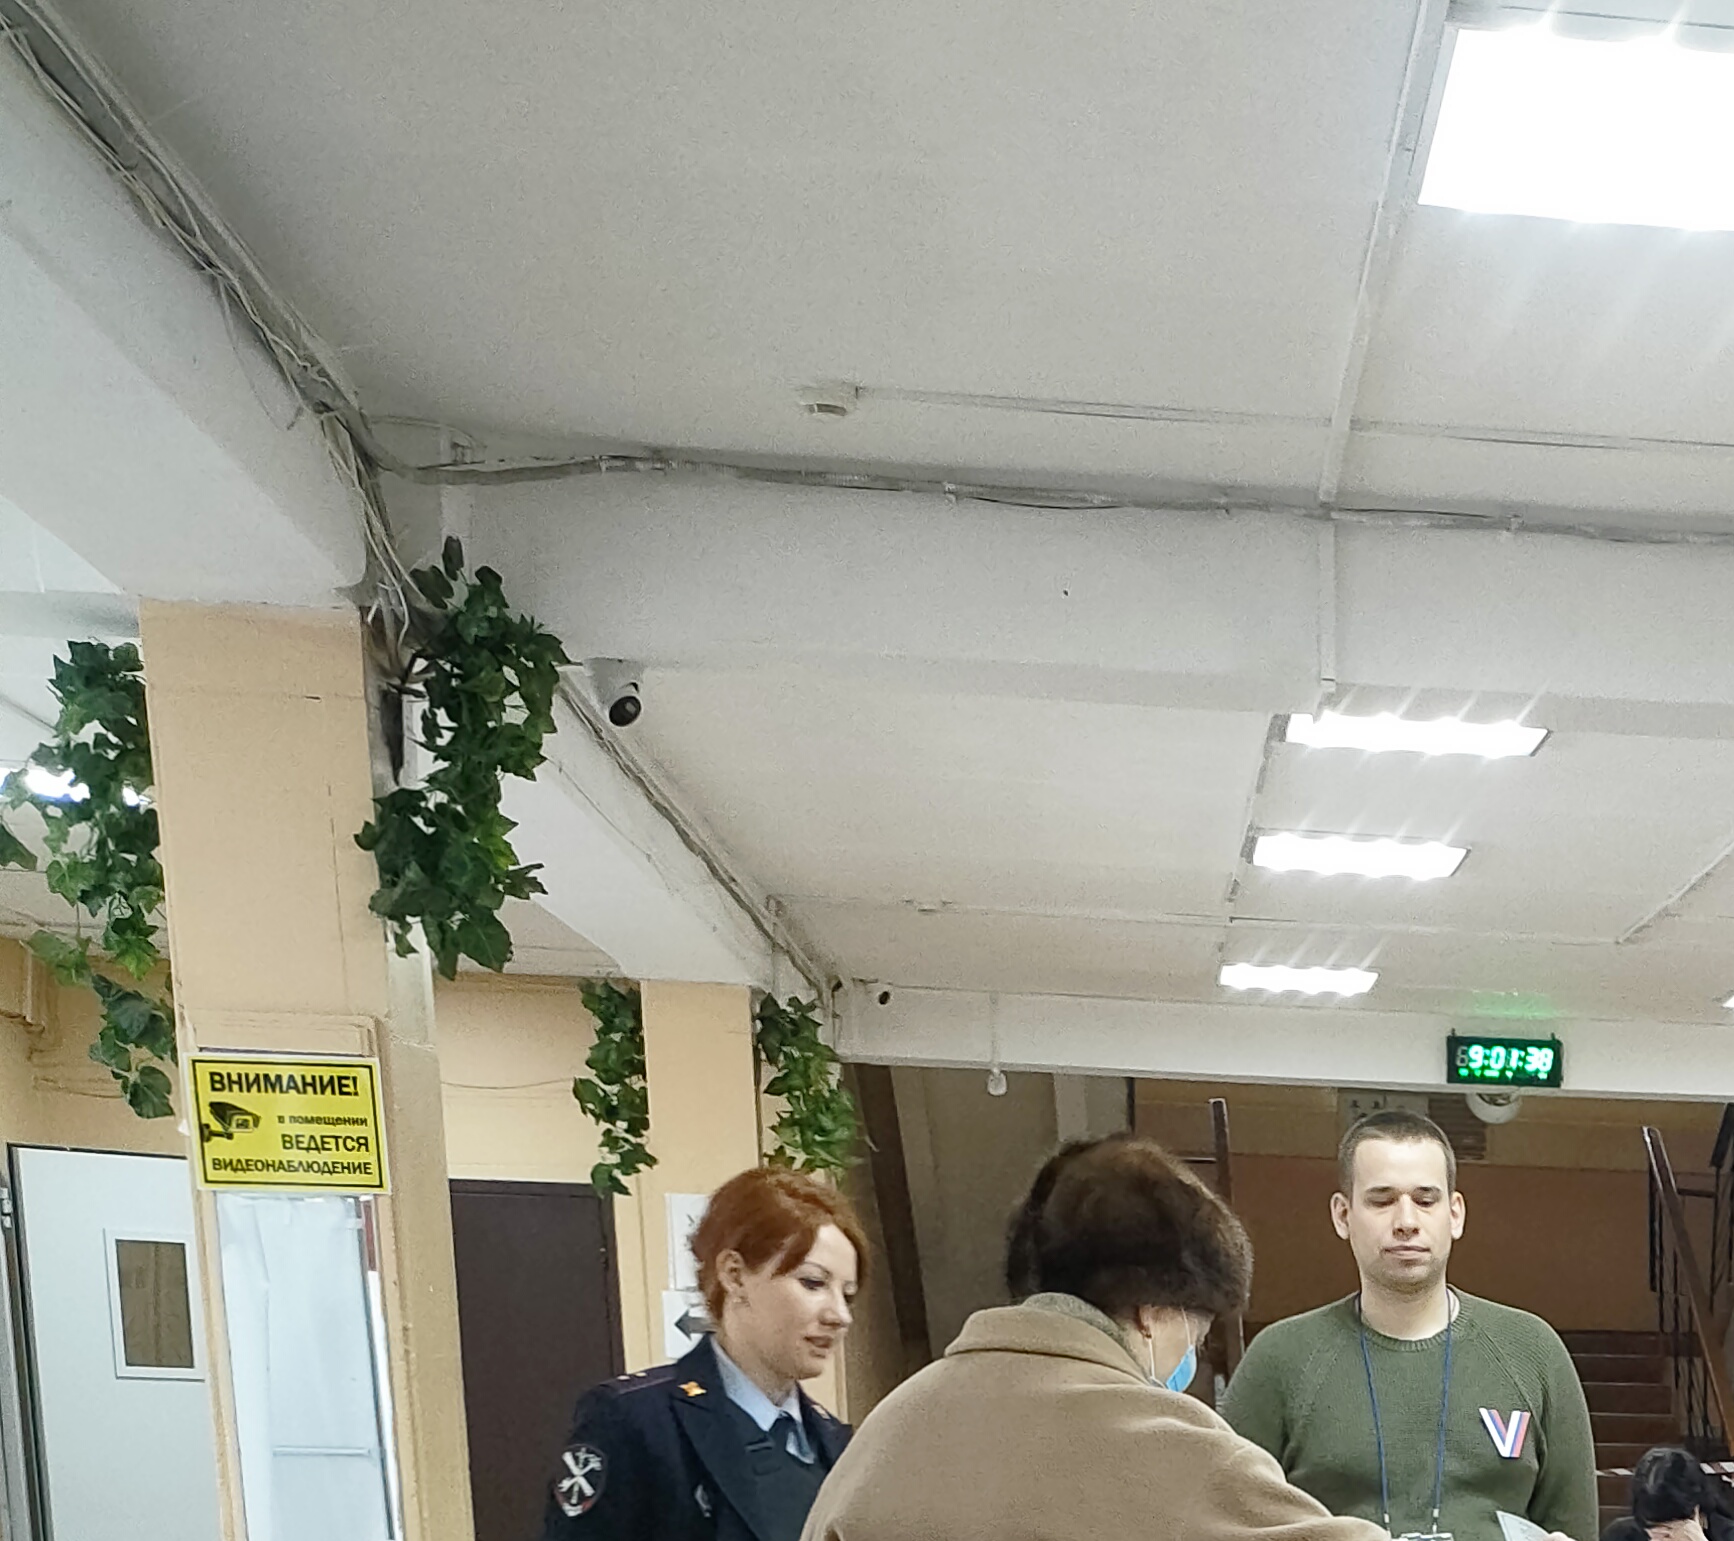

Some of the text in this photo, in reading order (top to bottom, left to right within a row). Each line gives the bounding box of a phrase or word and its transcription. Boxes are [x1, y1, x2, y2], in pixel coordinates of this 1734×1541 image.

[208, 1071, 360, 1097] ВНИМАНИЕ!
[277, 1114, 368, 1128] в помещении
[281, 1133, 370, 1153] ВЕДЕТСЯ
[212, 1157, 373, 1176] ВИДЕОНАБЛЮДЕНИЕ
